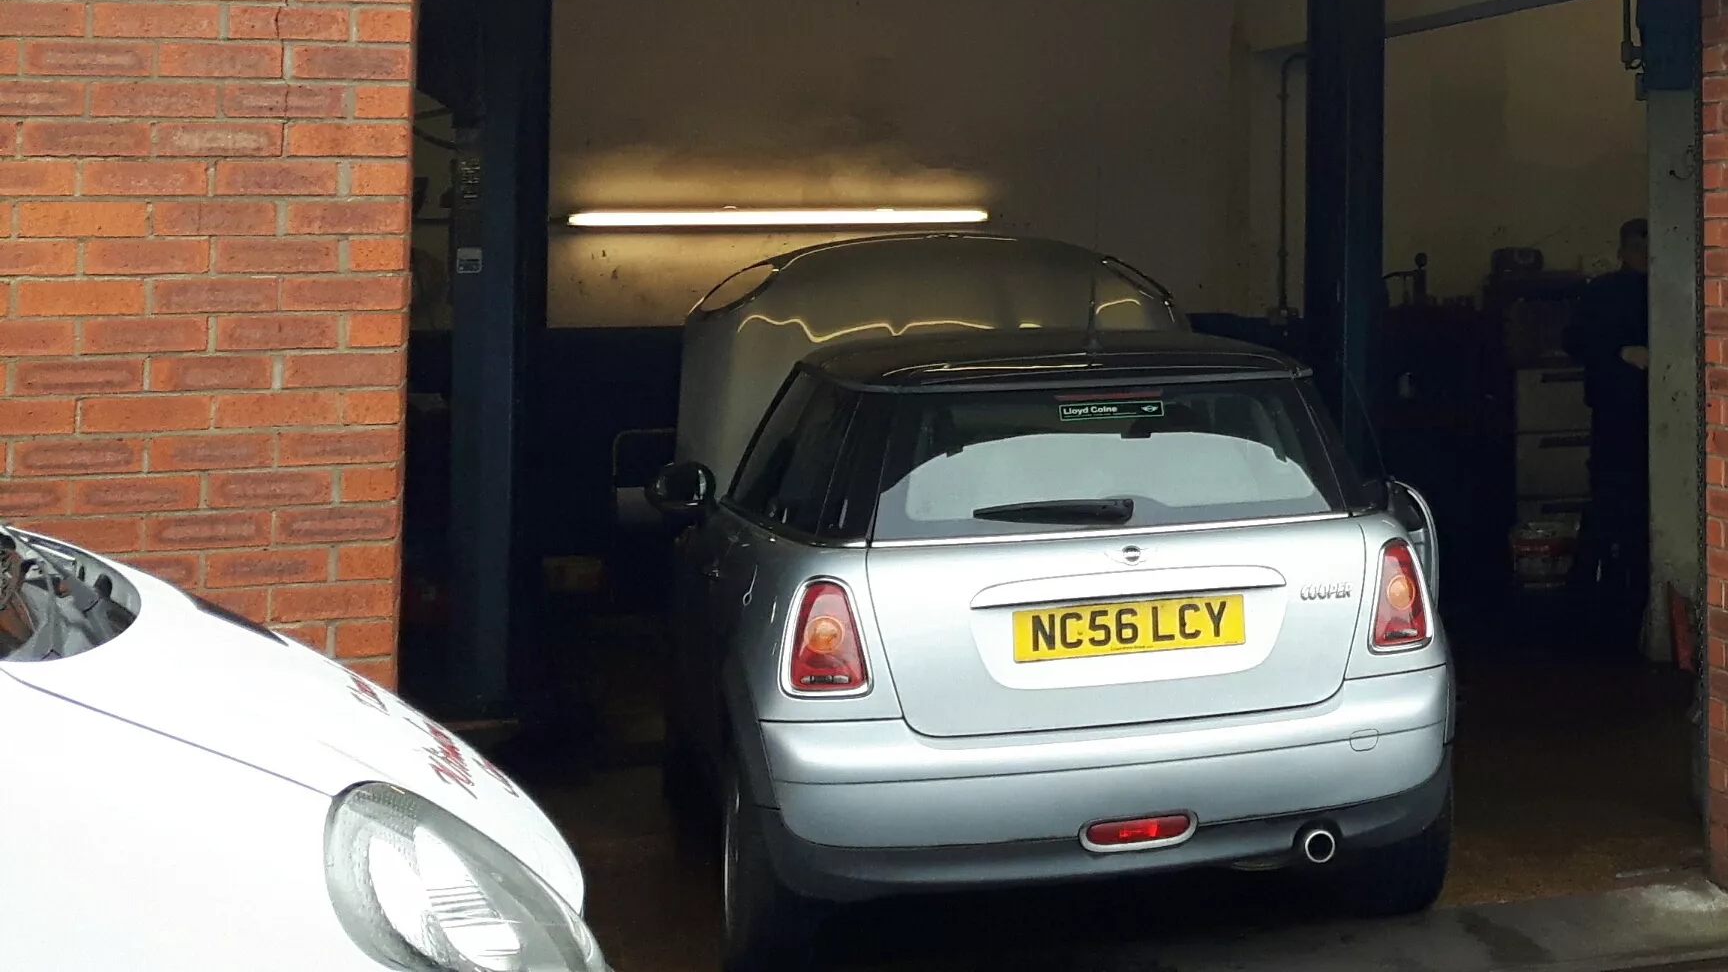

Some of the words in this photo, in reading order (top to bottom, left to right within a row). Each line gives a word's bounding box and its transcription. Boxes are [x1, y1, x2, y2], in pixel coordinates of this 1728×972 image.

[1063, 407, 1089, 415] Lloyd
[1299, 581, 1353, 601] COOPER
[1031, 607, 1139, 652] NC56
[1151, 602, 1228, 644] LCY
